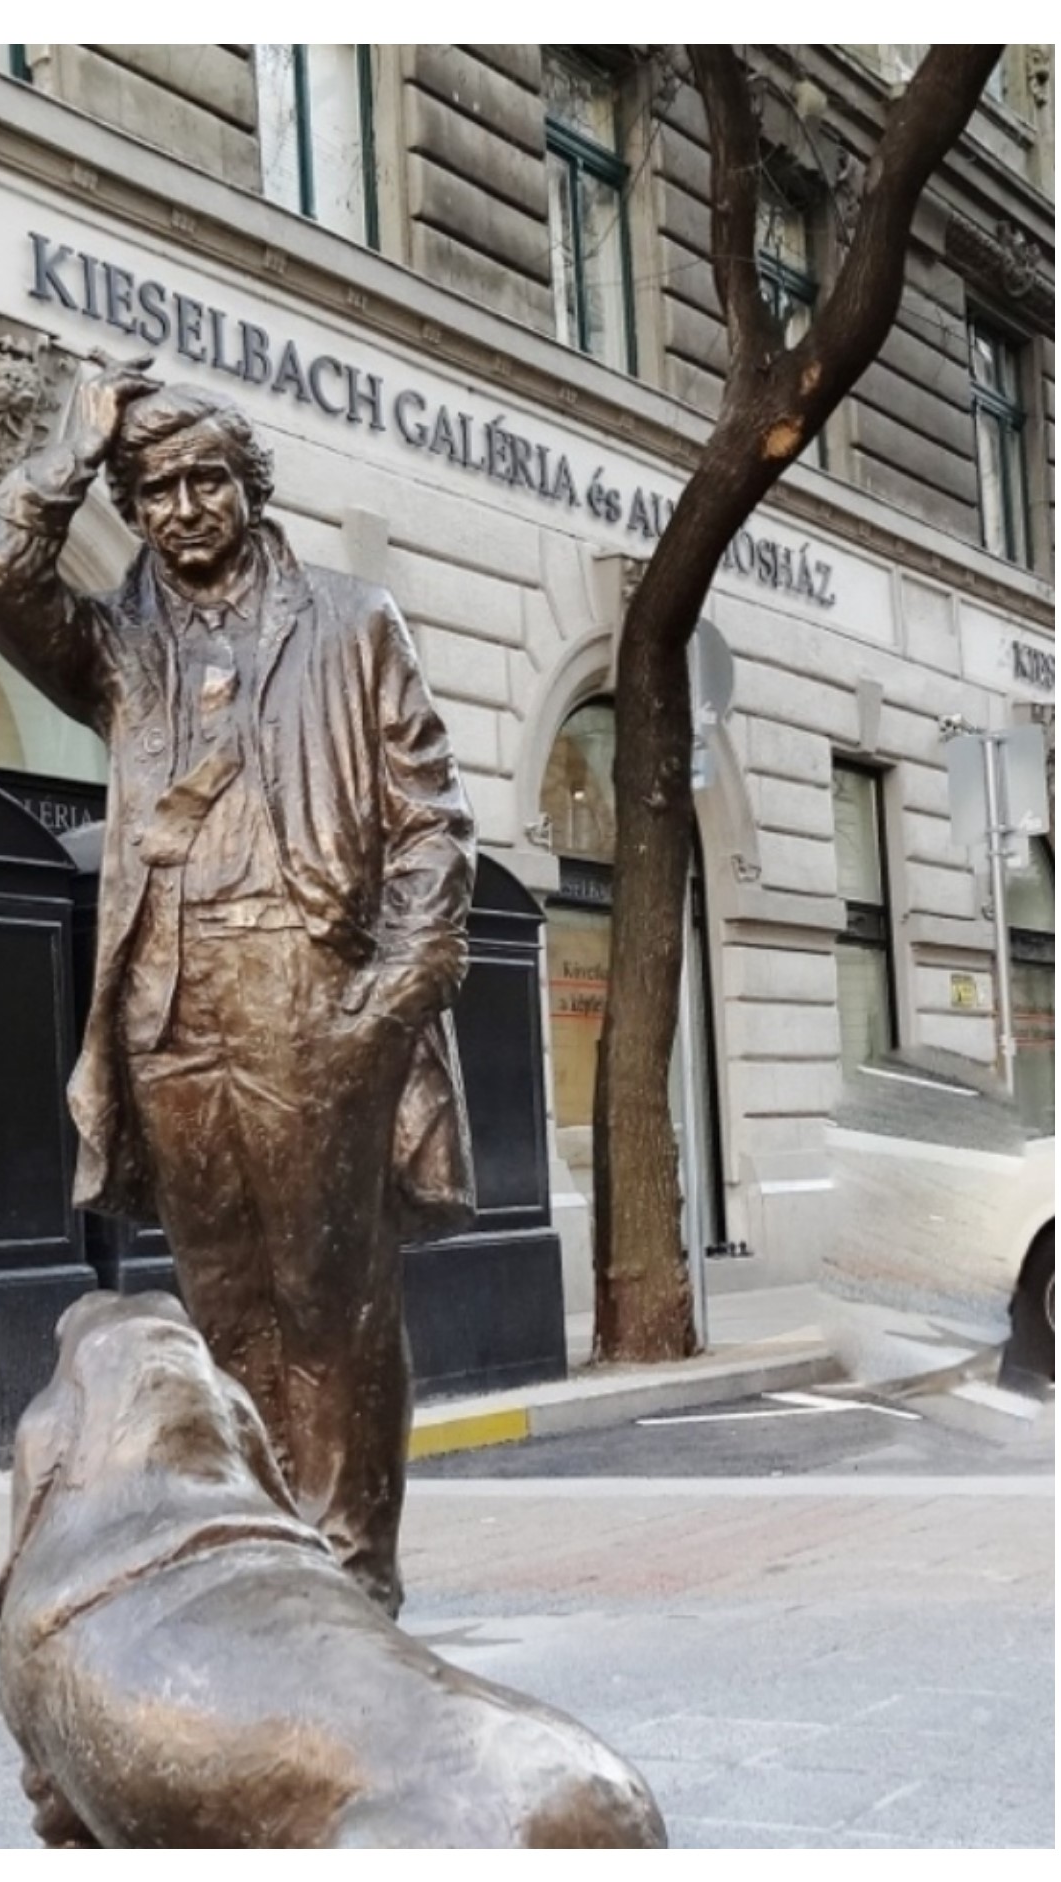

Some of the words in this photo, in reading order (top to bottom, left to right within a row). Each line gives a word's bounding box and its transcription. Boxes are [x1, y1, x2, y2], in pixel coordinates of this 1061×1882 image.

[27, 231, 386, 432] KIESELBACH
[394, 389, 580, 508] GALÉRIA
[587, 467, 621, 524] és
